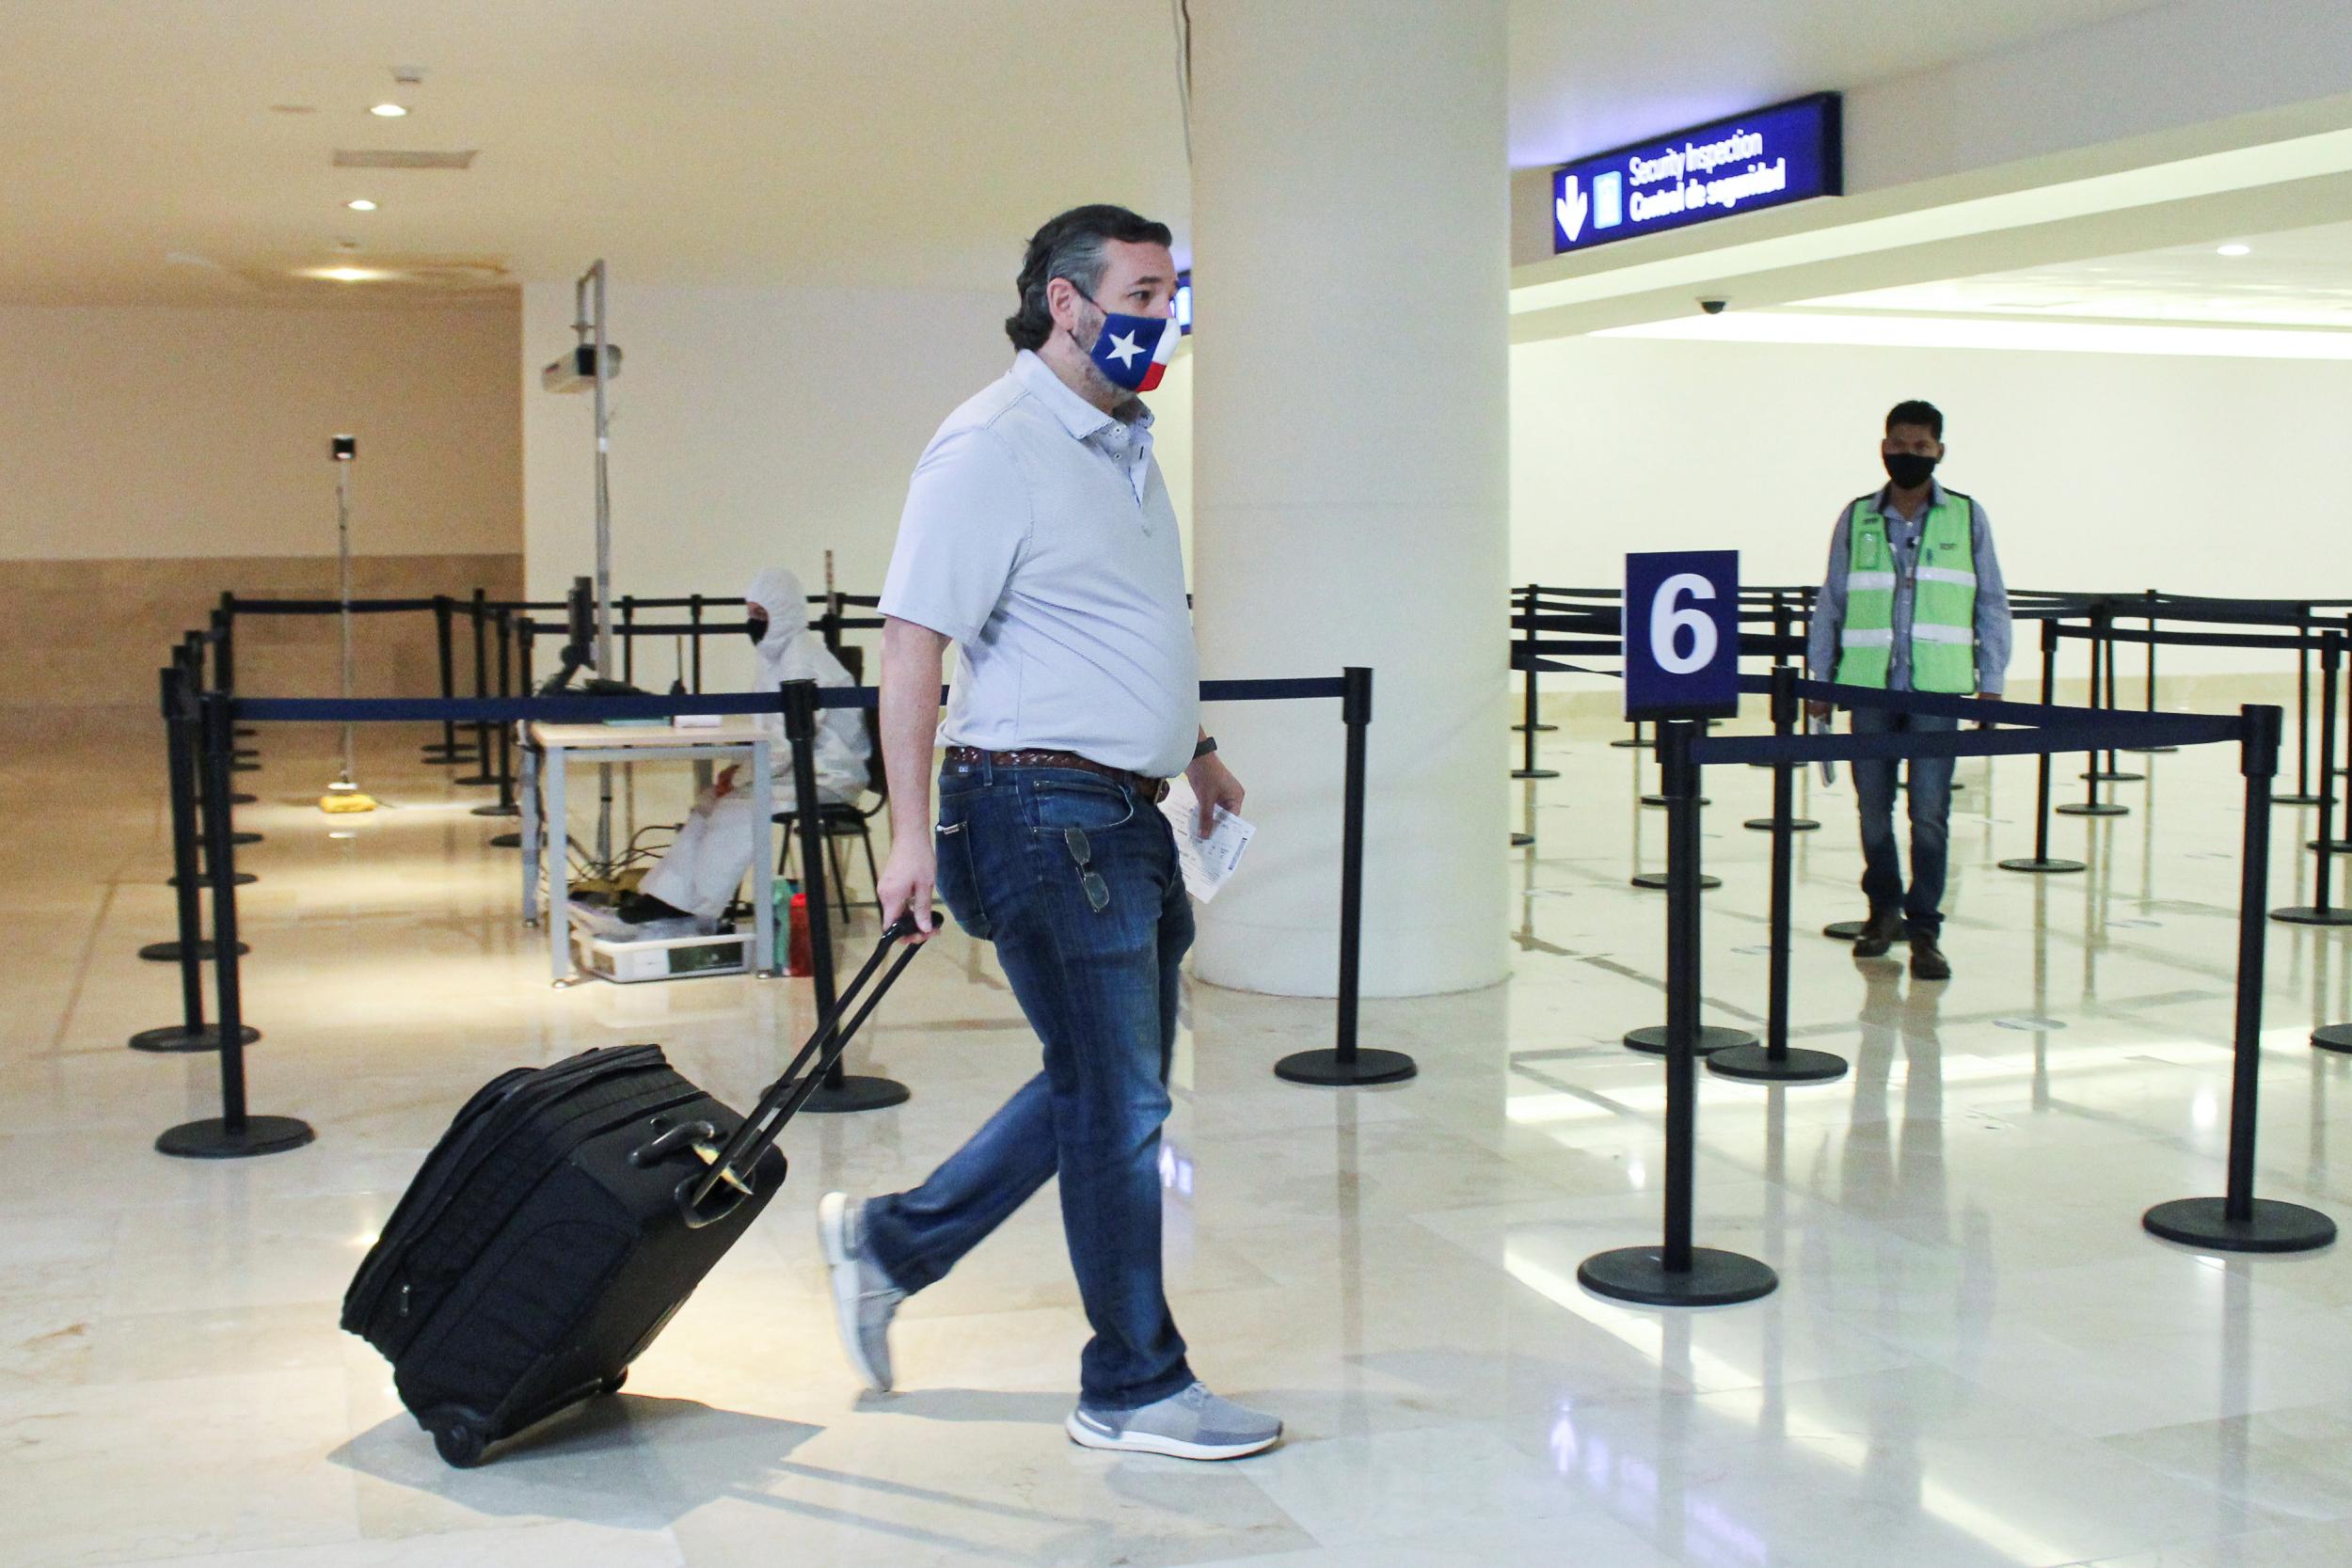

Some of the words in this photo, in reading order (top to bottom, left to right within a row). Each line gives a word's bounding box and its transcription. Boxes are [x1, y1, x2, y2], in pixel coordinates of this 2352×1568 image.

[1629, 148, 1685, 186] Security
[1685, 129, 1763, 174] Inspection
[1629, 182, 1685, 222] Control
[1685, 179, 1707, 210] de
[1707, 157, 1786, 208] seguridad
[1650, 573, 1718, 675] 6
